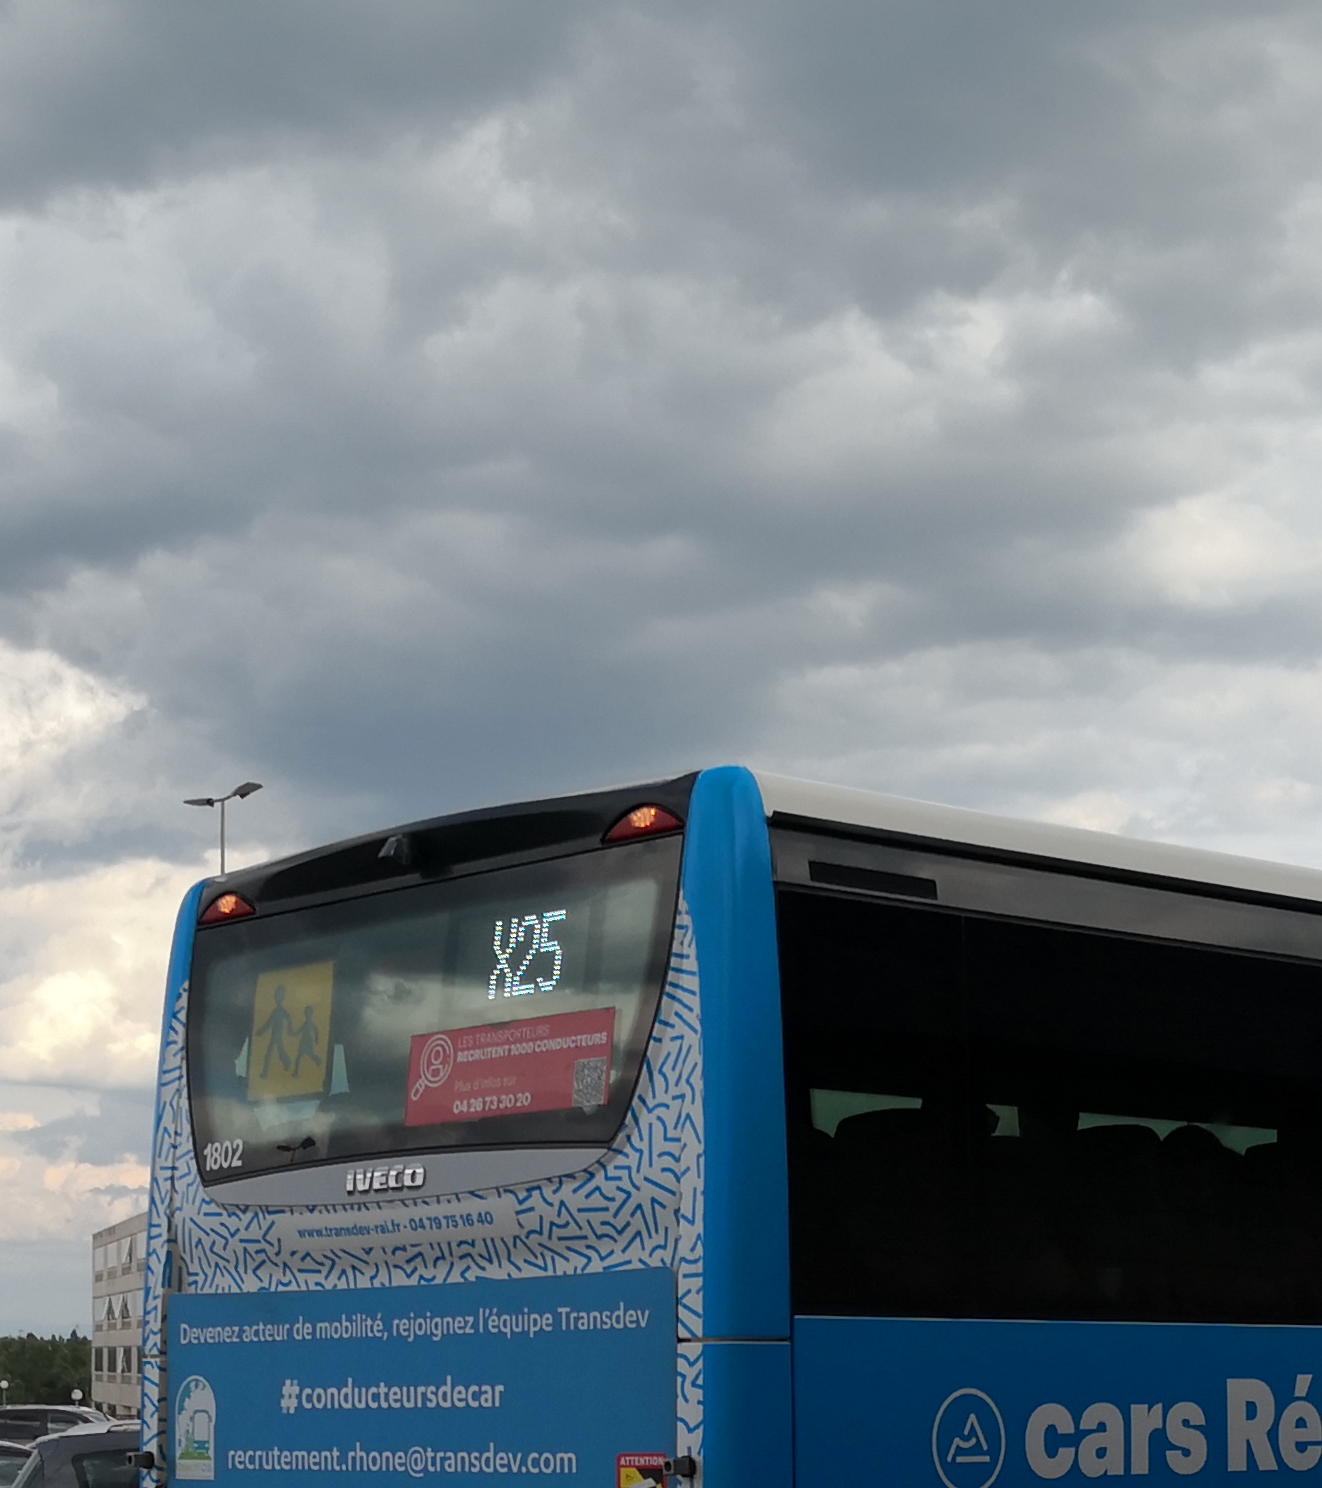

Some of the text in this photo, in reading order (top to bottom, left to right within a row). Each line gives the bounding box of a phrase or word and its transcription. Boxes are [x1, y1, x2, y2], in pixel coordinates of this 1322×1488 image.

[488, 909, 567, 1000] X25
[457, 1032, 608, 1063] RECRUTENT 1000 CONDUCTEURS
[458, 1024, 550, 1048] LES TRANSPORTEURS
[453, 1100, 468, 1114] 04
[484, 1095, 497, 1111] 73
[499, 1094, 515, 1109] 30
[516, 1092, 532, 1107] 20
[203, 1139, 244, 1172] 1802
[345, 1163, 427, 1195] IVECO
[409, 1218, 426, 1232] 04
[427, 1216, 443, 1230] 79
[445, 1214, 459, 1229] 75
[460, 1213, 475, 1228] 16
[477, 1211, 495, 1226] 40
[180, 1302, 650, 1345] Devenez acteur de mobilité, rejoignez l'équipe Transdev
[280, 1375, 504, 1414] #conducteursdecar
[1024, 1401, 1208, 1479] cars
[227, 1441, 578, 1478] recrutement.rhone@transdev.com
